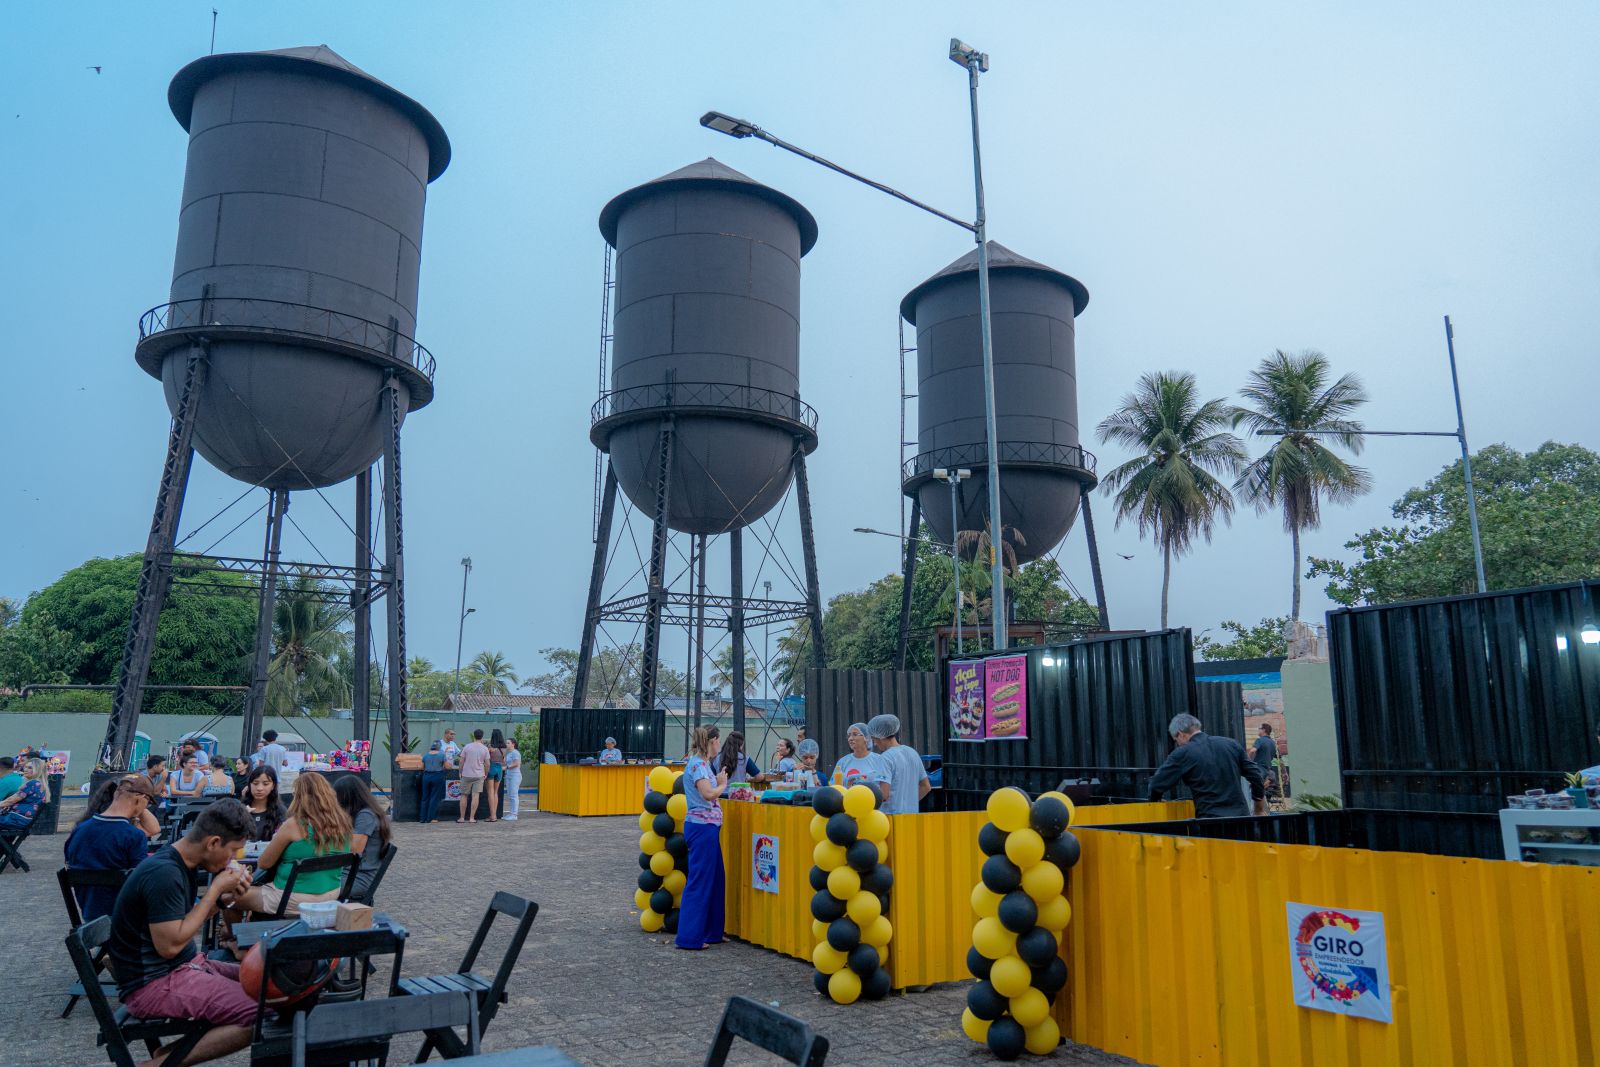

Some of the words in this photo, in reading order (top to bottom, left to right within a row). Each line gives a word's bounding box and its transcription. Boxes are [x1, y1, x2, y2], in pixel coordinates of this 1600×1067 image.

[991, 669, 1005, 682] HOT
[1006, 668, 1020, 681] DOG
[760, 850, 773, 860] GIRO
[1314, 935, 1363, 956] GIRO
[1314, 953, 1364, 965] EMPREENDEDOR
